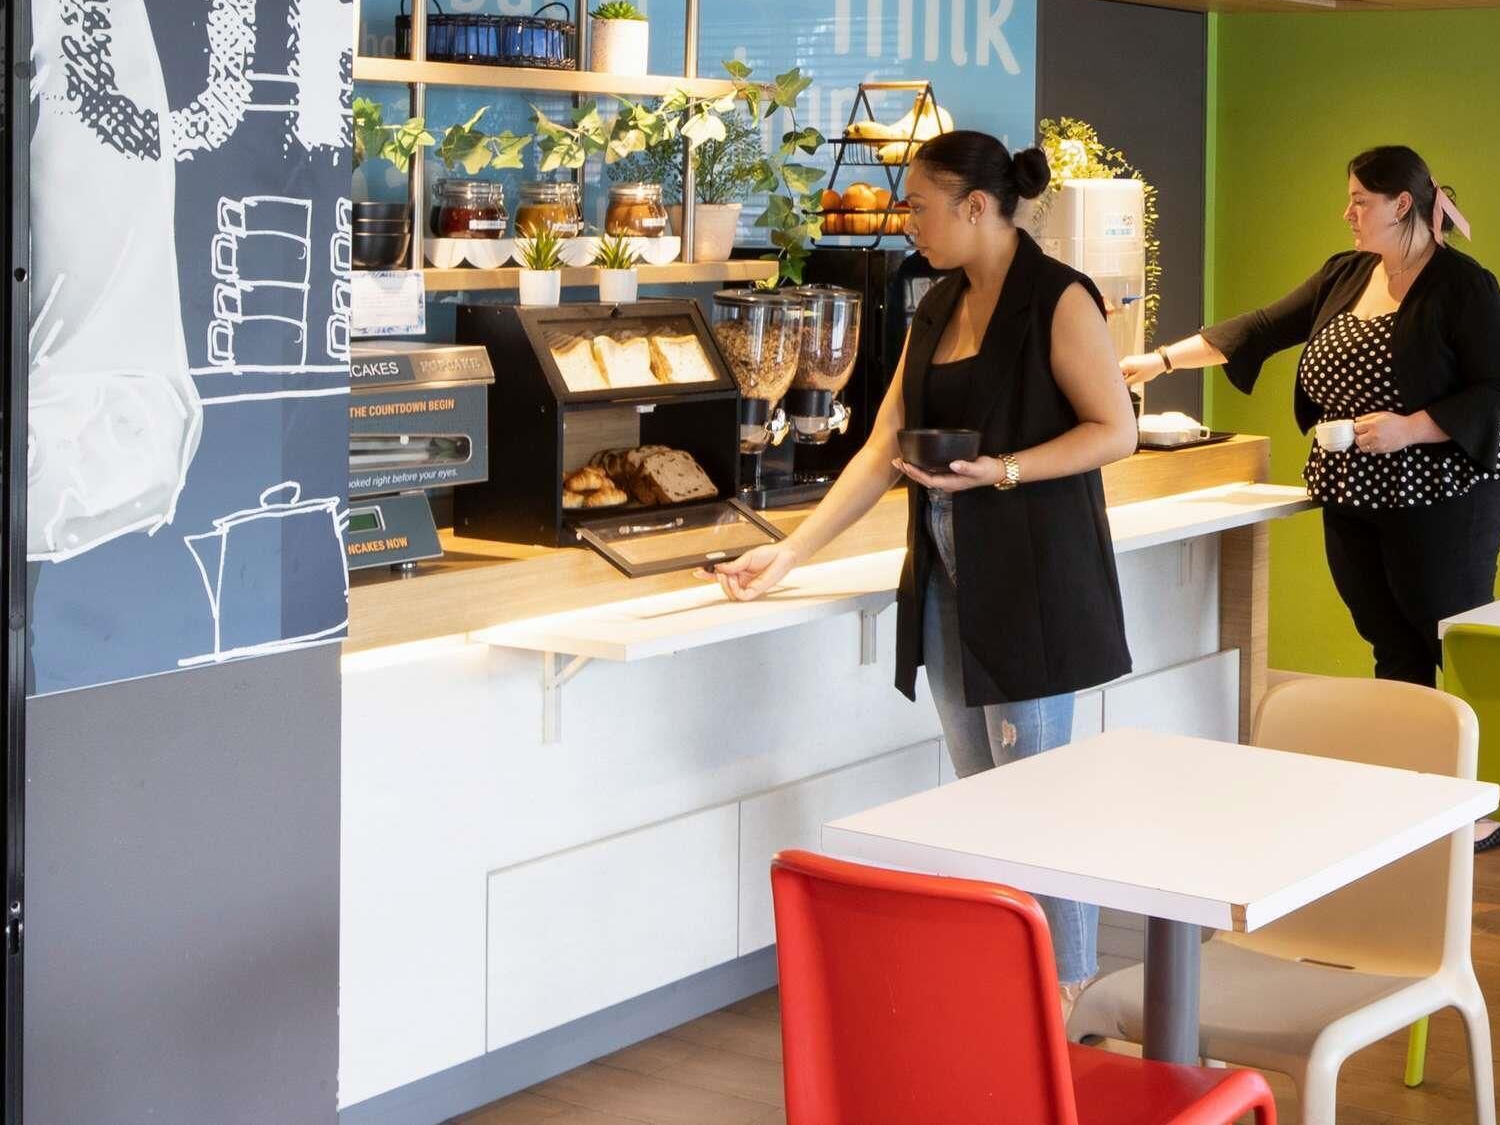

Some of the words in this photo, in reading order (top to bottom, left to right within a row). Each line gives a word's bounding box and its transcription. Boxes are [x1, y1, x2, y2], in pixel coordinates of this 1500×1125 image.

[350, 361, 399, 378] CAKES
[368, 400, 427, 417] COUNTDOWN
[428, 398, 456, 412] BEGIN
[372, 475, 391, 487] right
[391, 471, 418, 484] before
[418, 470, 437, 482] your
[385, 536, 408, 550] NOW
